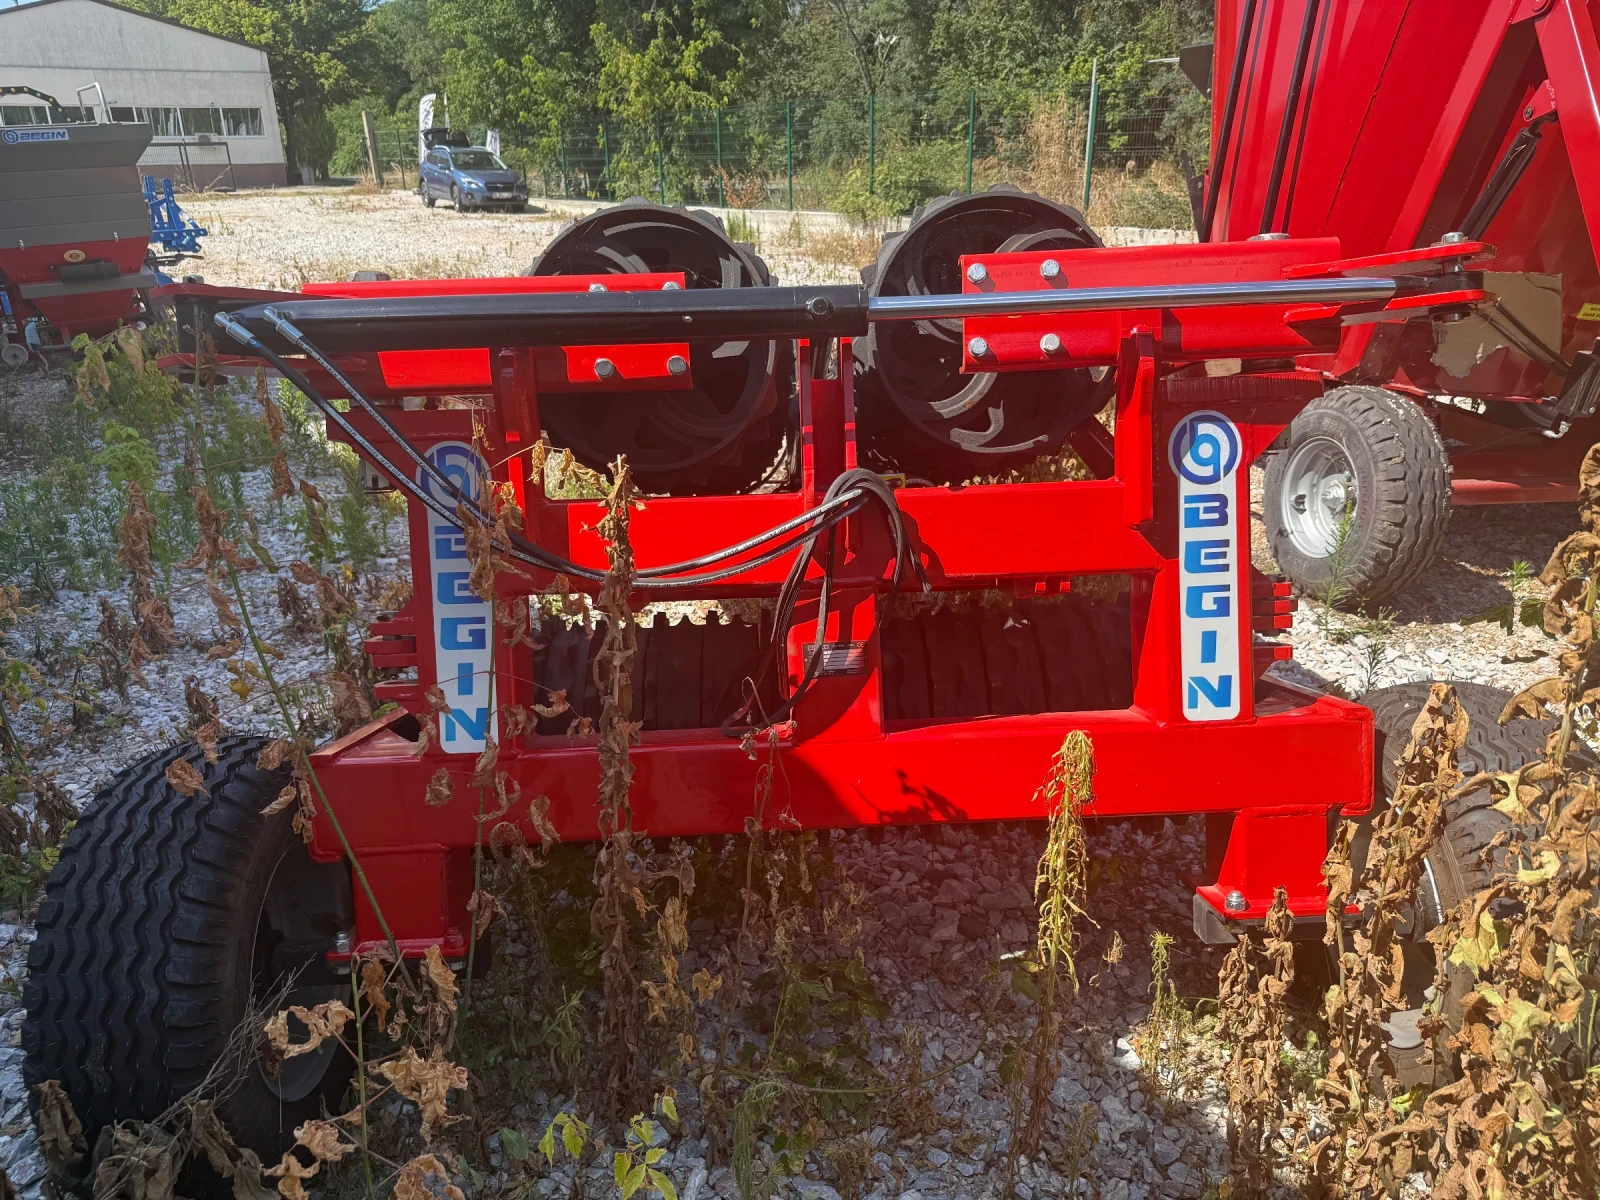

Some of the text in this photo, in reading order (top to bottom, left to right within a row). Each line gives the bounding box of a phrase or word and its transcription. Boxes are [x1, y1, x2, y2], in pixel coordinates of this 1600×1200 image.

[20, 131, 66, 141] BEGIN
[434, 525, 489, 743] BEGIN
[1183, 493, 1232, 710] BEGIN
